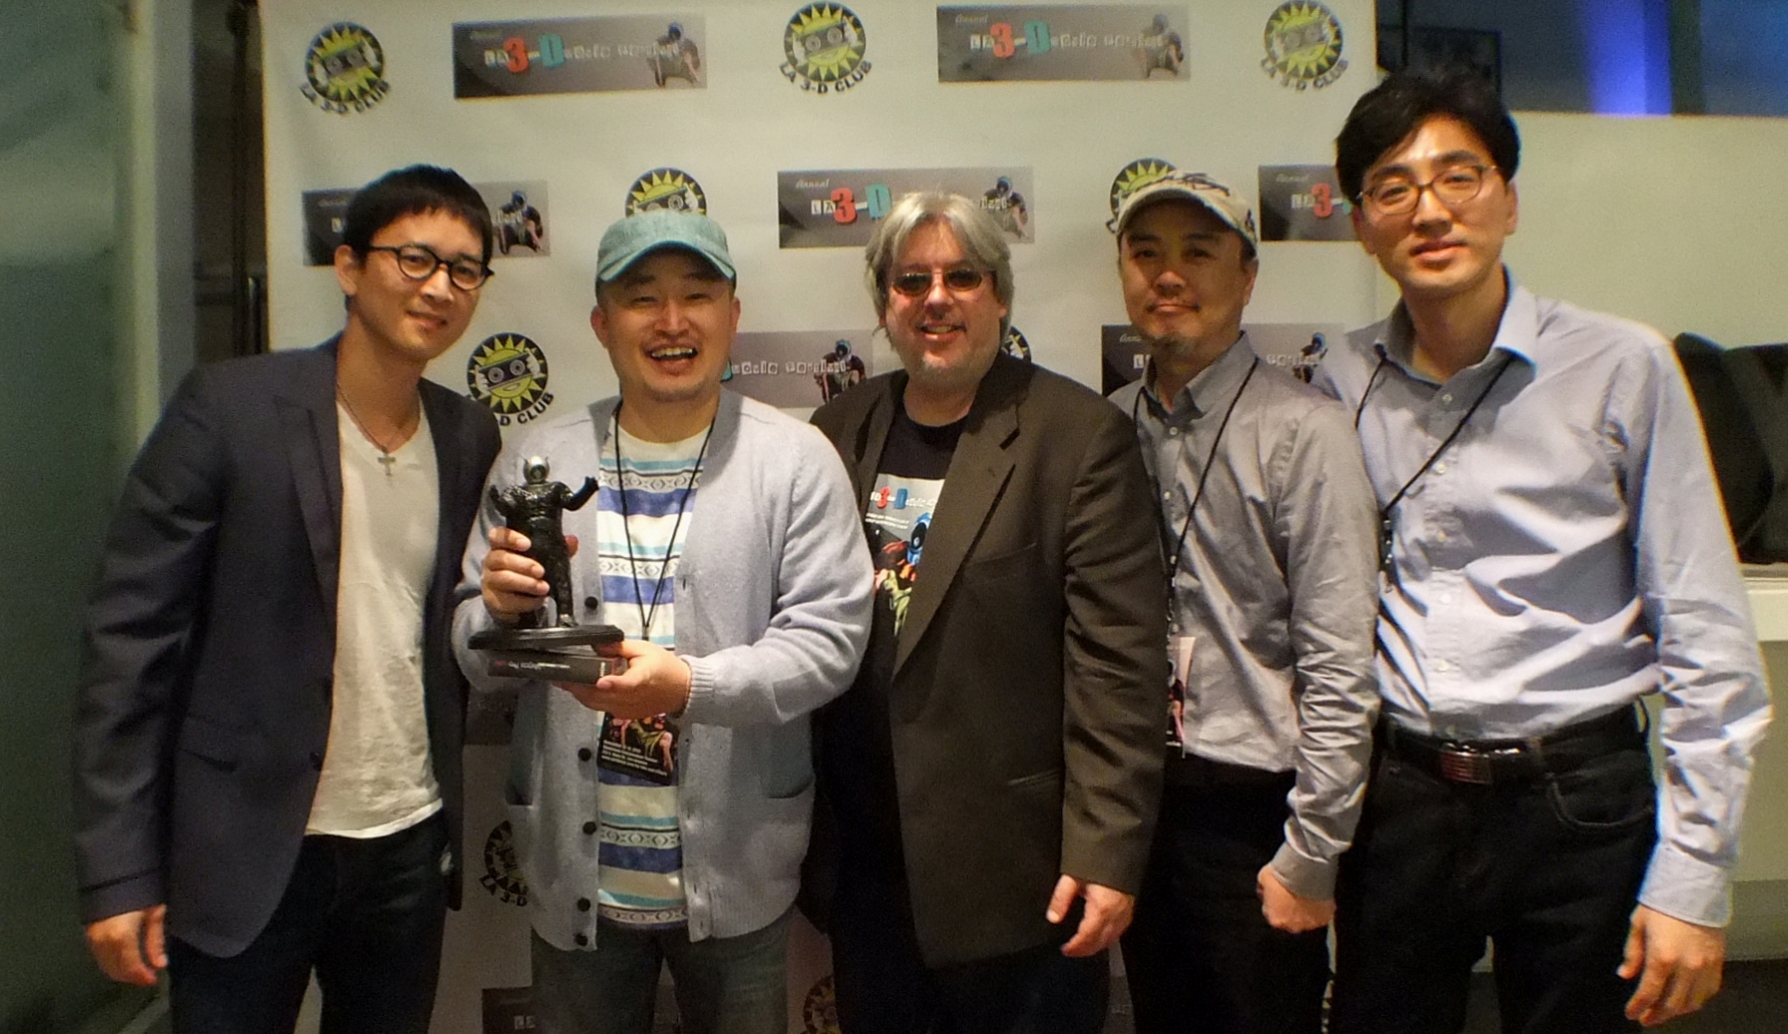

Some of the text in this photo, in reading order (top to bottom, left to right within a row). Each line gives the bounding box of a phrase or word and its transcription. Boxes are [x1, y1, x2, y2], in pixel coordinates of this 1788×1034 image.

[801, 80, 828, 94] 3-D
[835, 60, 872, 92] CLUB
[1313, 59, 1349, 89] CLUB
[355, 80, 390, 113] CLUB
[517, 392, 554, 425] CLUB
